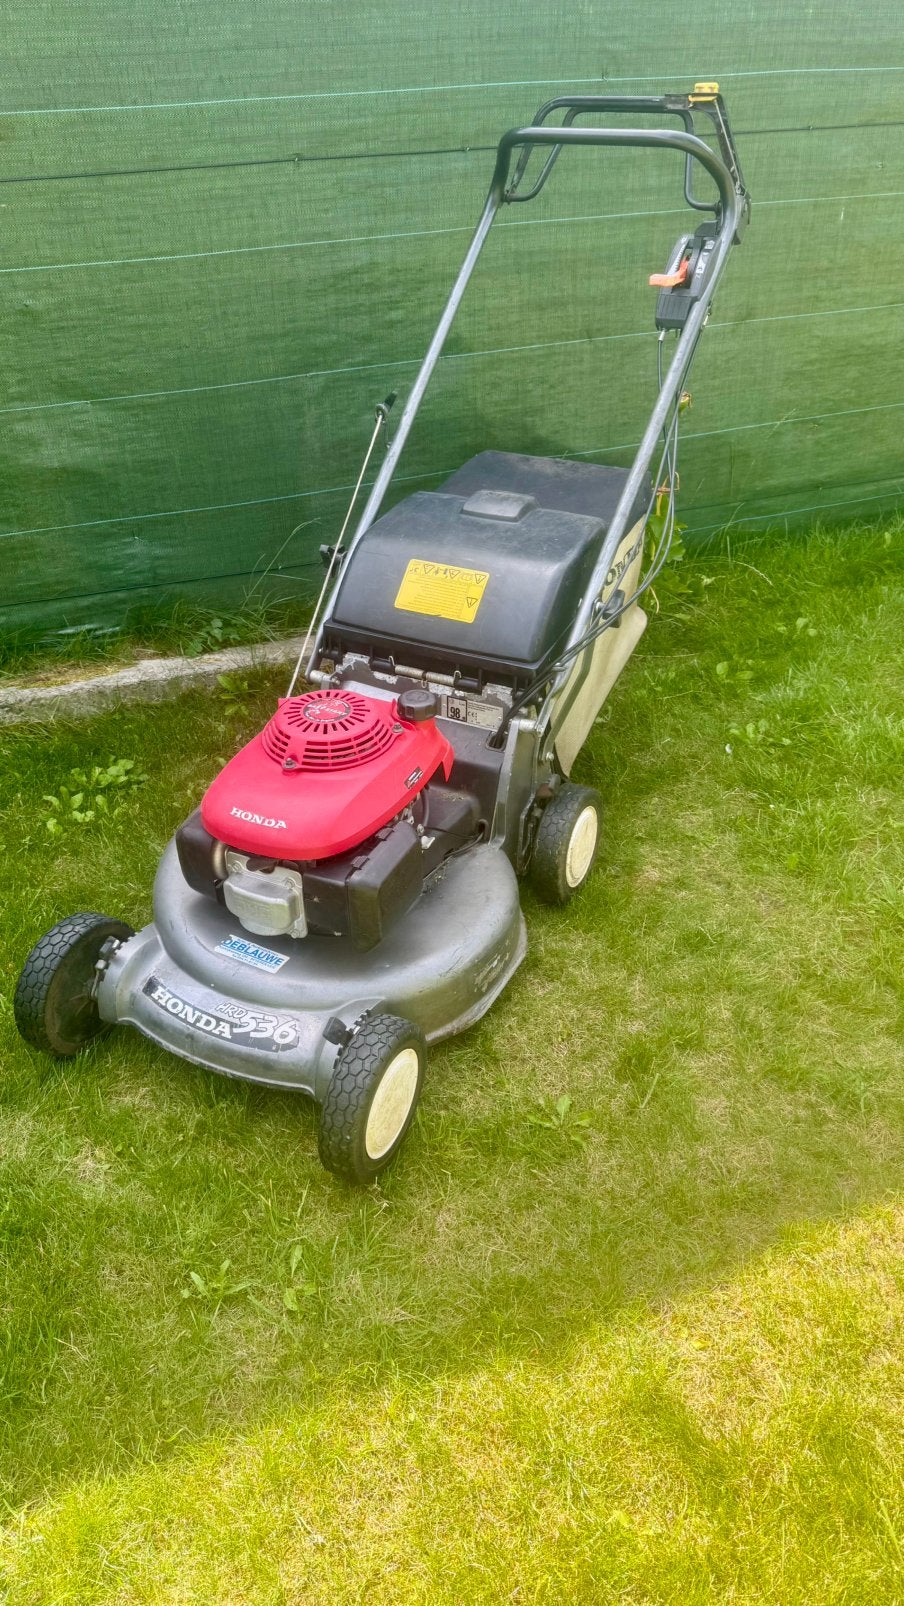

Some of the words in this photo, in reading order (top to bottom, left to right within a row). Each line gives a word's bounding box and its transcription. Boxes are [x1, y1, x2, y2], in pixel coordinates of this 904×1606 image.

[450, 706, 461, 719] 98
[230, 807, 288, 830] HONDA
[151, 985, 234, 1039] HONDA
[215, 1001, 247, 1023] HRD
[232, 1011, 299, 1044] 536
